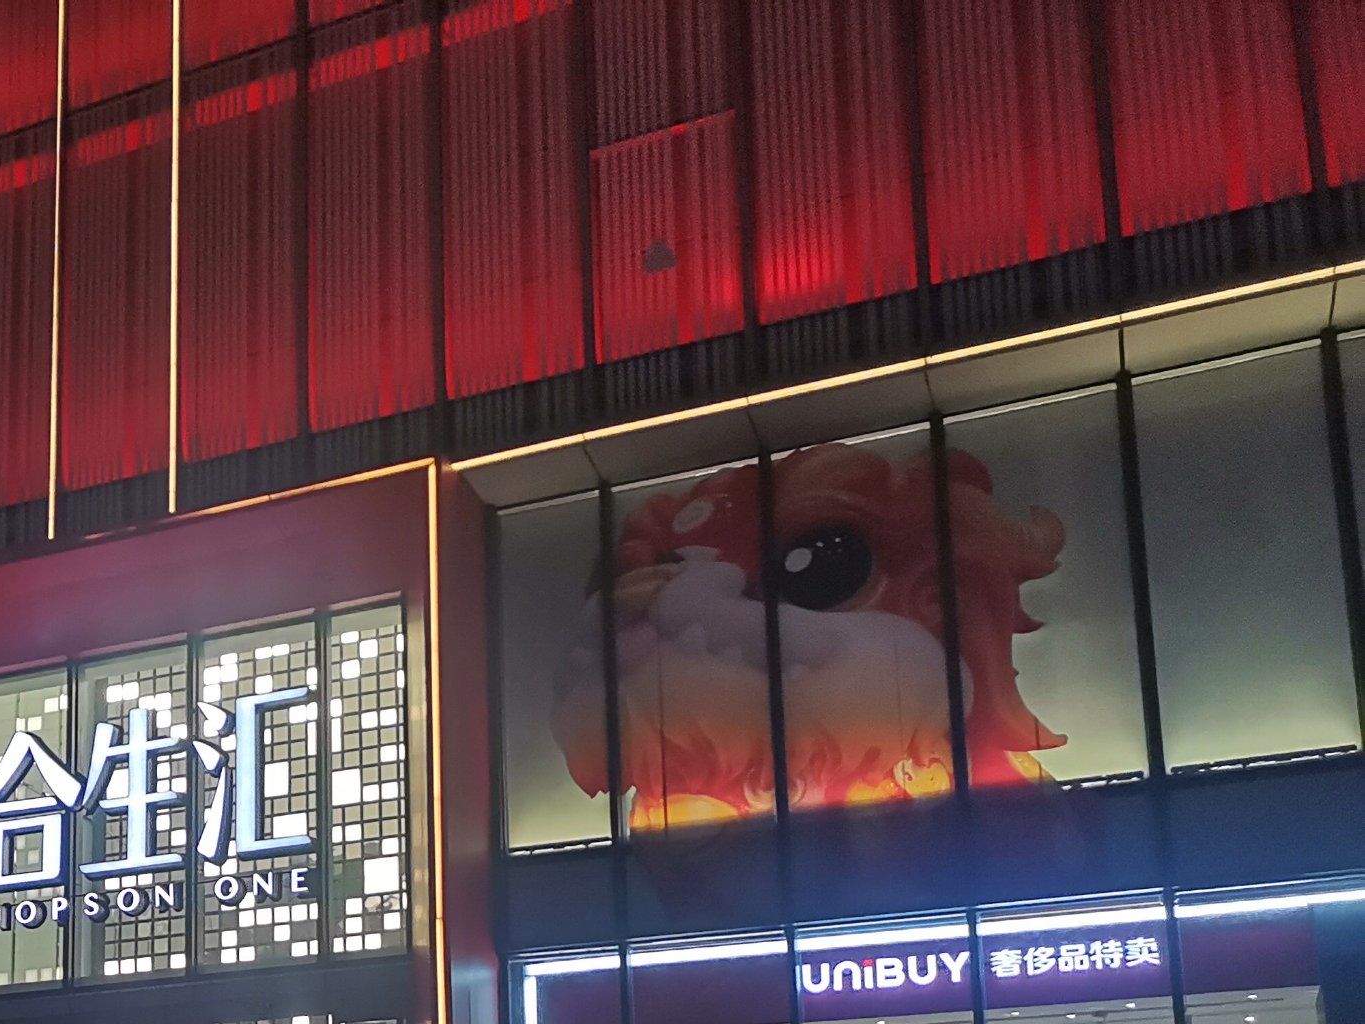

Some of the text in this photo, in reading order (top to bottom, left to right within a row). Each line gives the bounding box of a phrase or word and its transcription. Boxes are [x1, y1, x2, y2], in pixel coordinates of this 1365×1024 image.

[214, 866, 310, 903] ONE
[989, 936, 1162, 979] 奢侈品特卖
